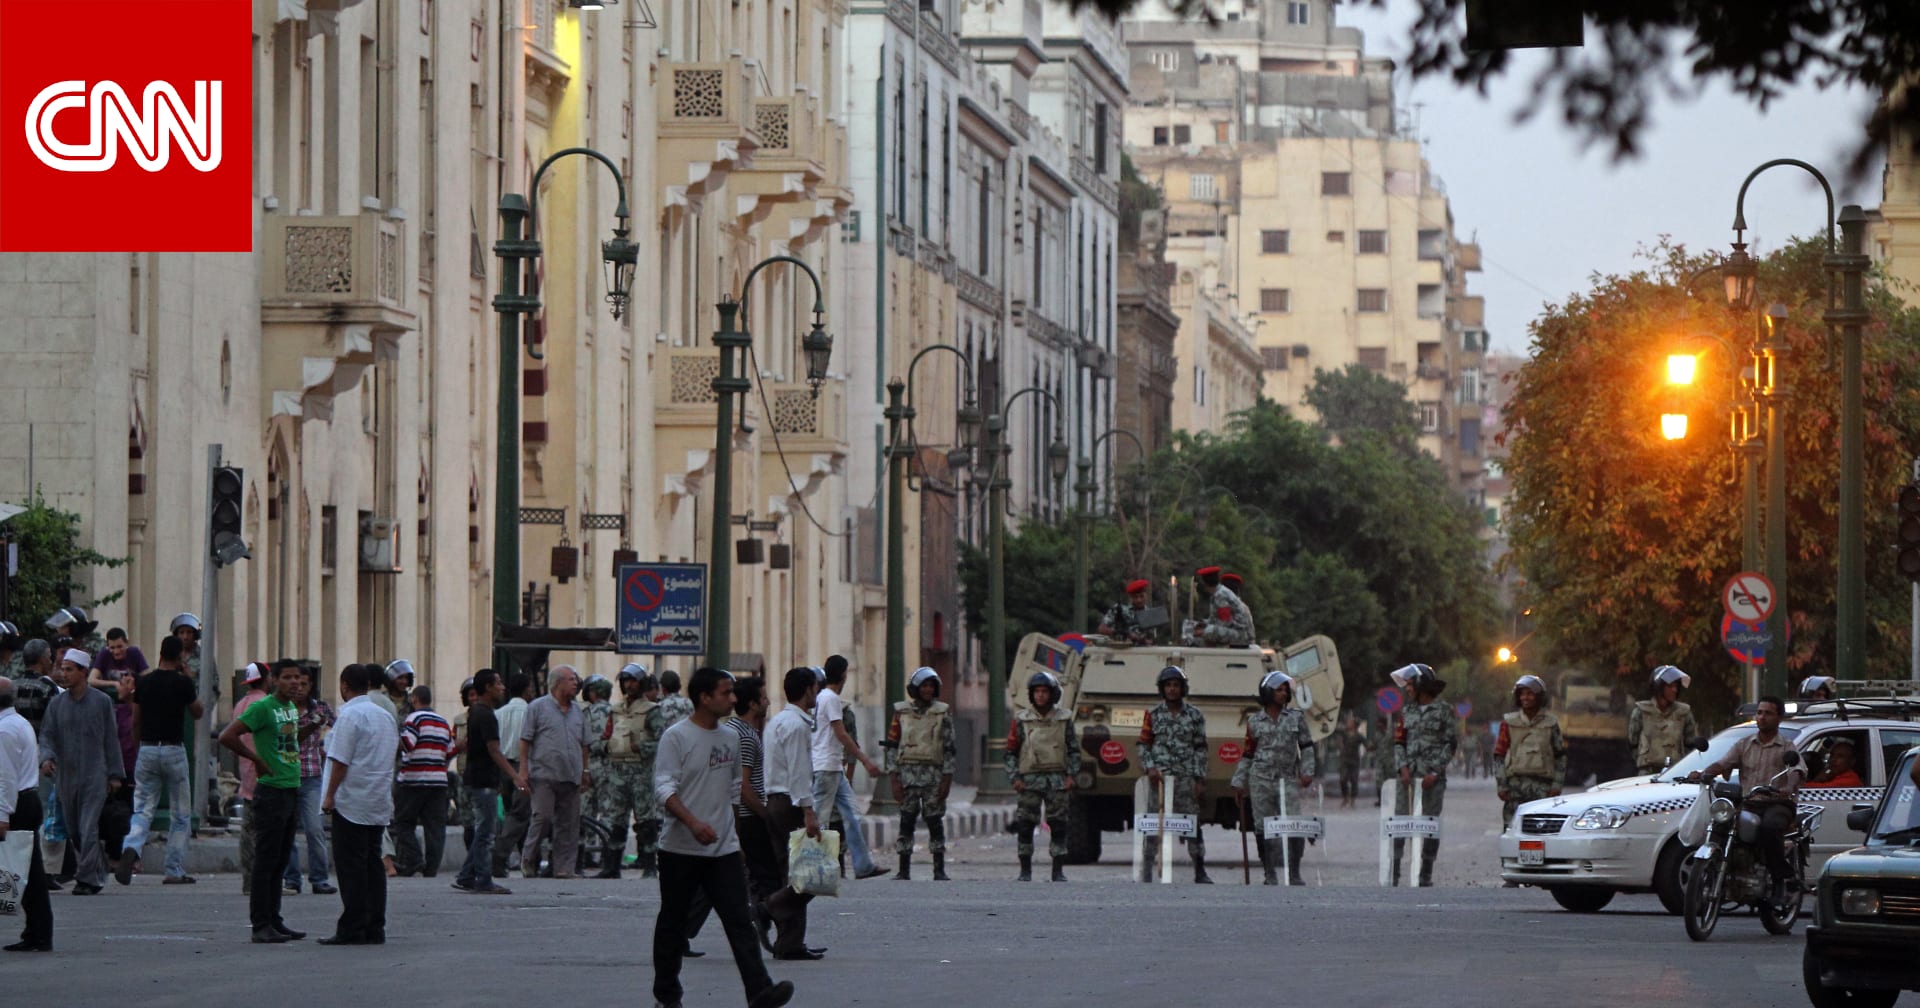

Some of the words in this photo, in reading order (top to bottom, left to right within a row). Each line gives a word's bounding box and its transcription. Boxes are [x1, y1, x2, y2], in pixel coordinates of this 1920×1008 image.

[664, 574, 701, 591] ممنوع
[652, 605, 700, 622] الانتظار
[626, 618, 647, 631] احذر
[1141, 820, 1162, 828] Arme
[1165, 820, 1190, 828] Forces
[1270, 822, 1295, 831] Armed
[1386, 822, 1409, 830] Armed
[1410, 822, 1436, 830] Forces
